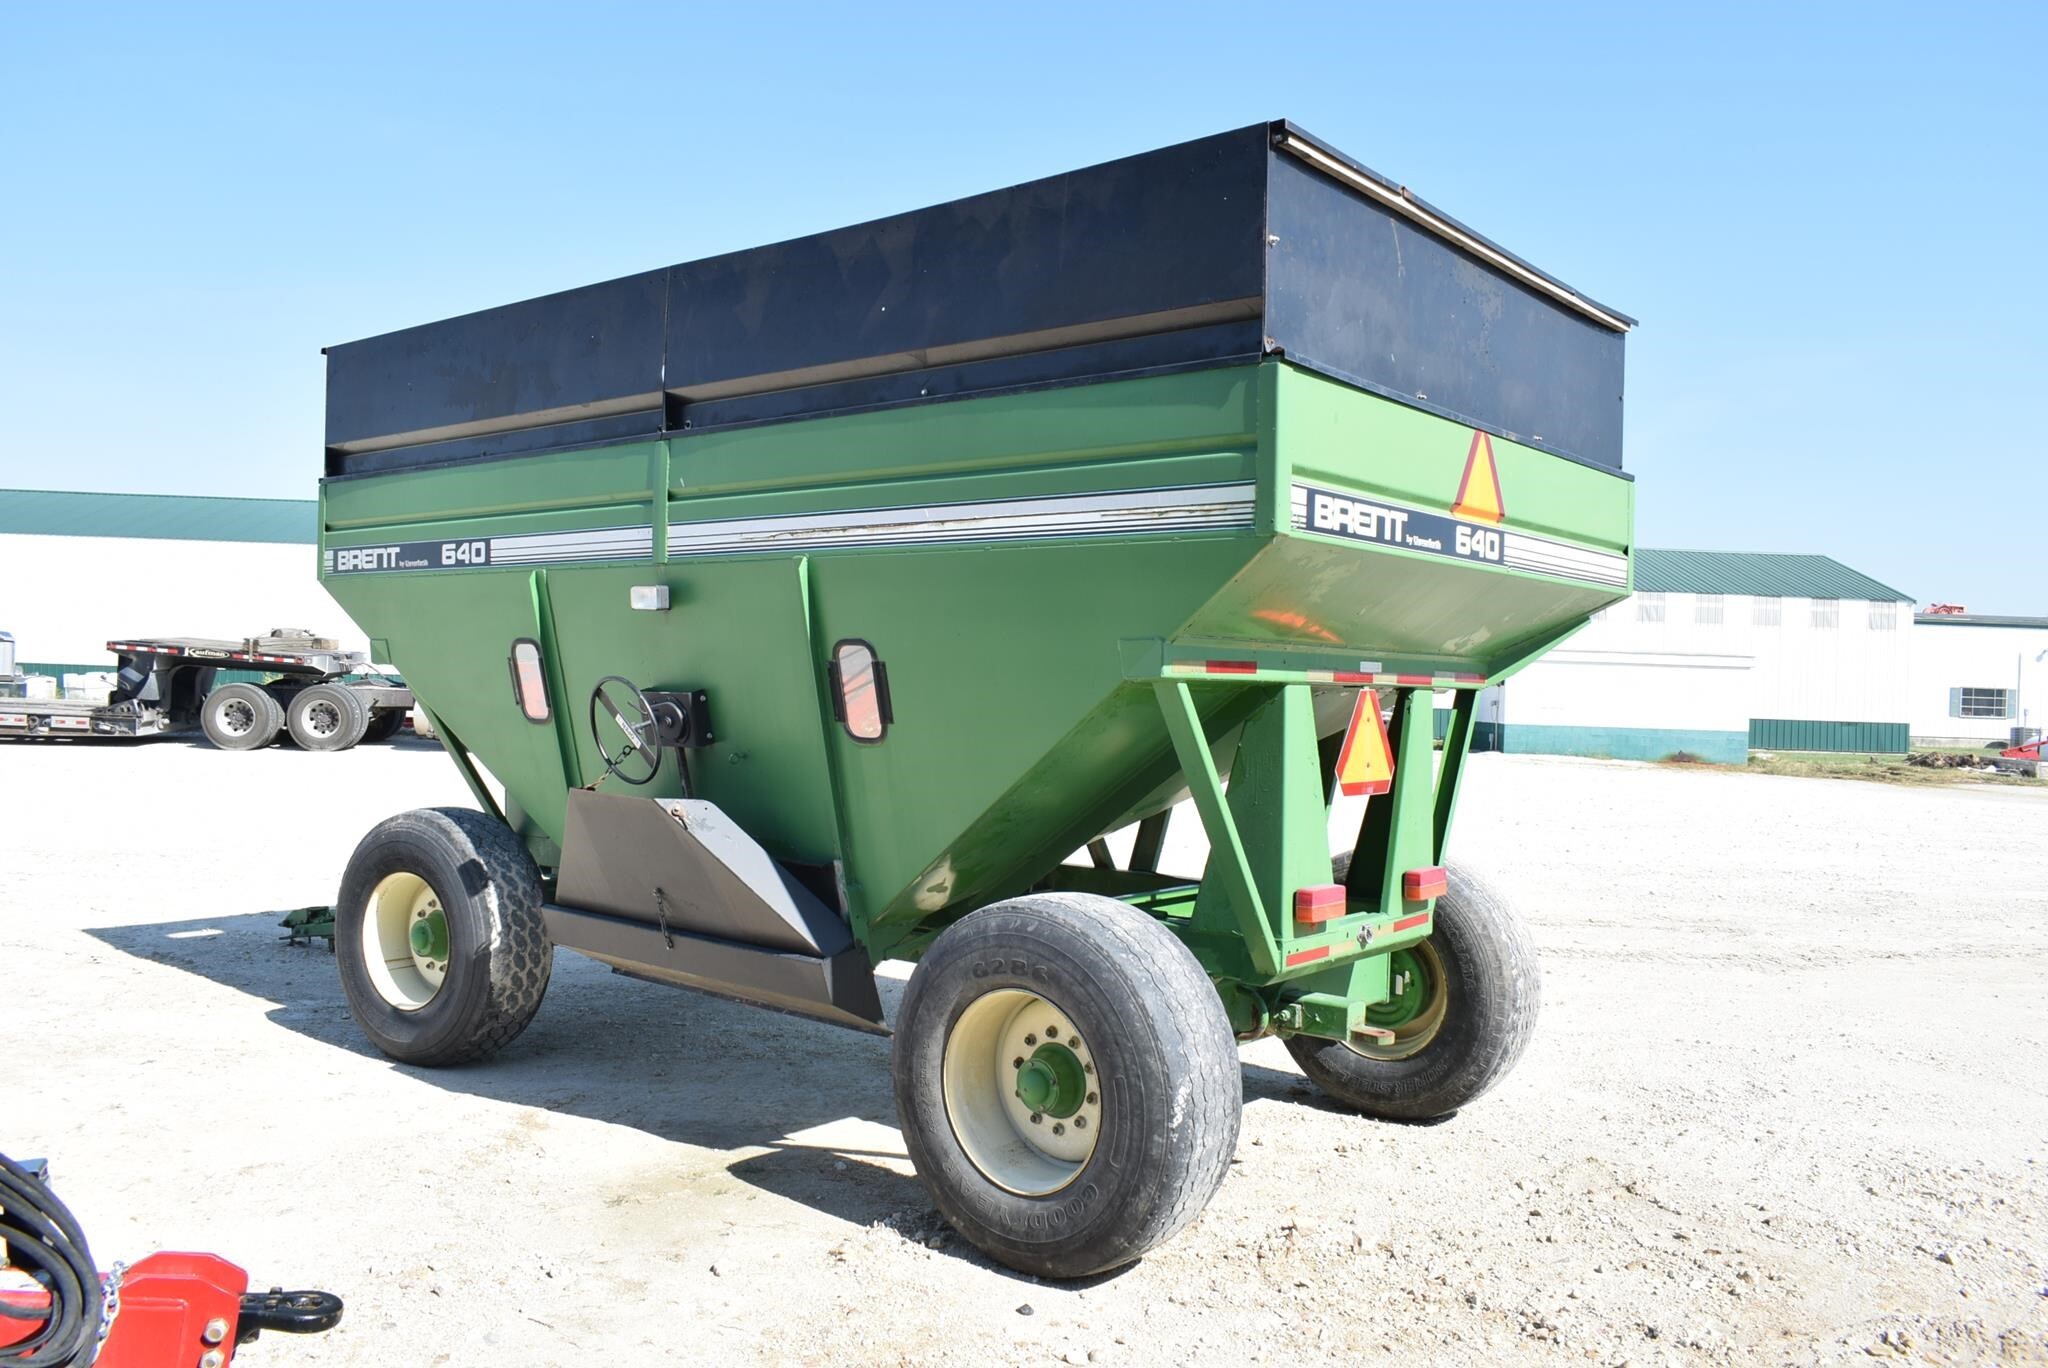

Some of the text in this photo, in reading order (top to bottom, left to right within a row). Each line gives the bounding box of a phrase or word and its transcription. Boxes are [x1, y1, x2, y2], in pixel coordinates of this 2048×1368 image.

[1314, 494, 1408, 543] BRENT
[1455, 525, 1500, 561] 640
[337, 547, 401, 571] BRENT
[441, 542, 486, 566] 640
[182, 647, 226, 659] Kaufman
[942, 1155, 1101, 1233] GOODYEAR
